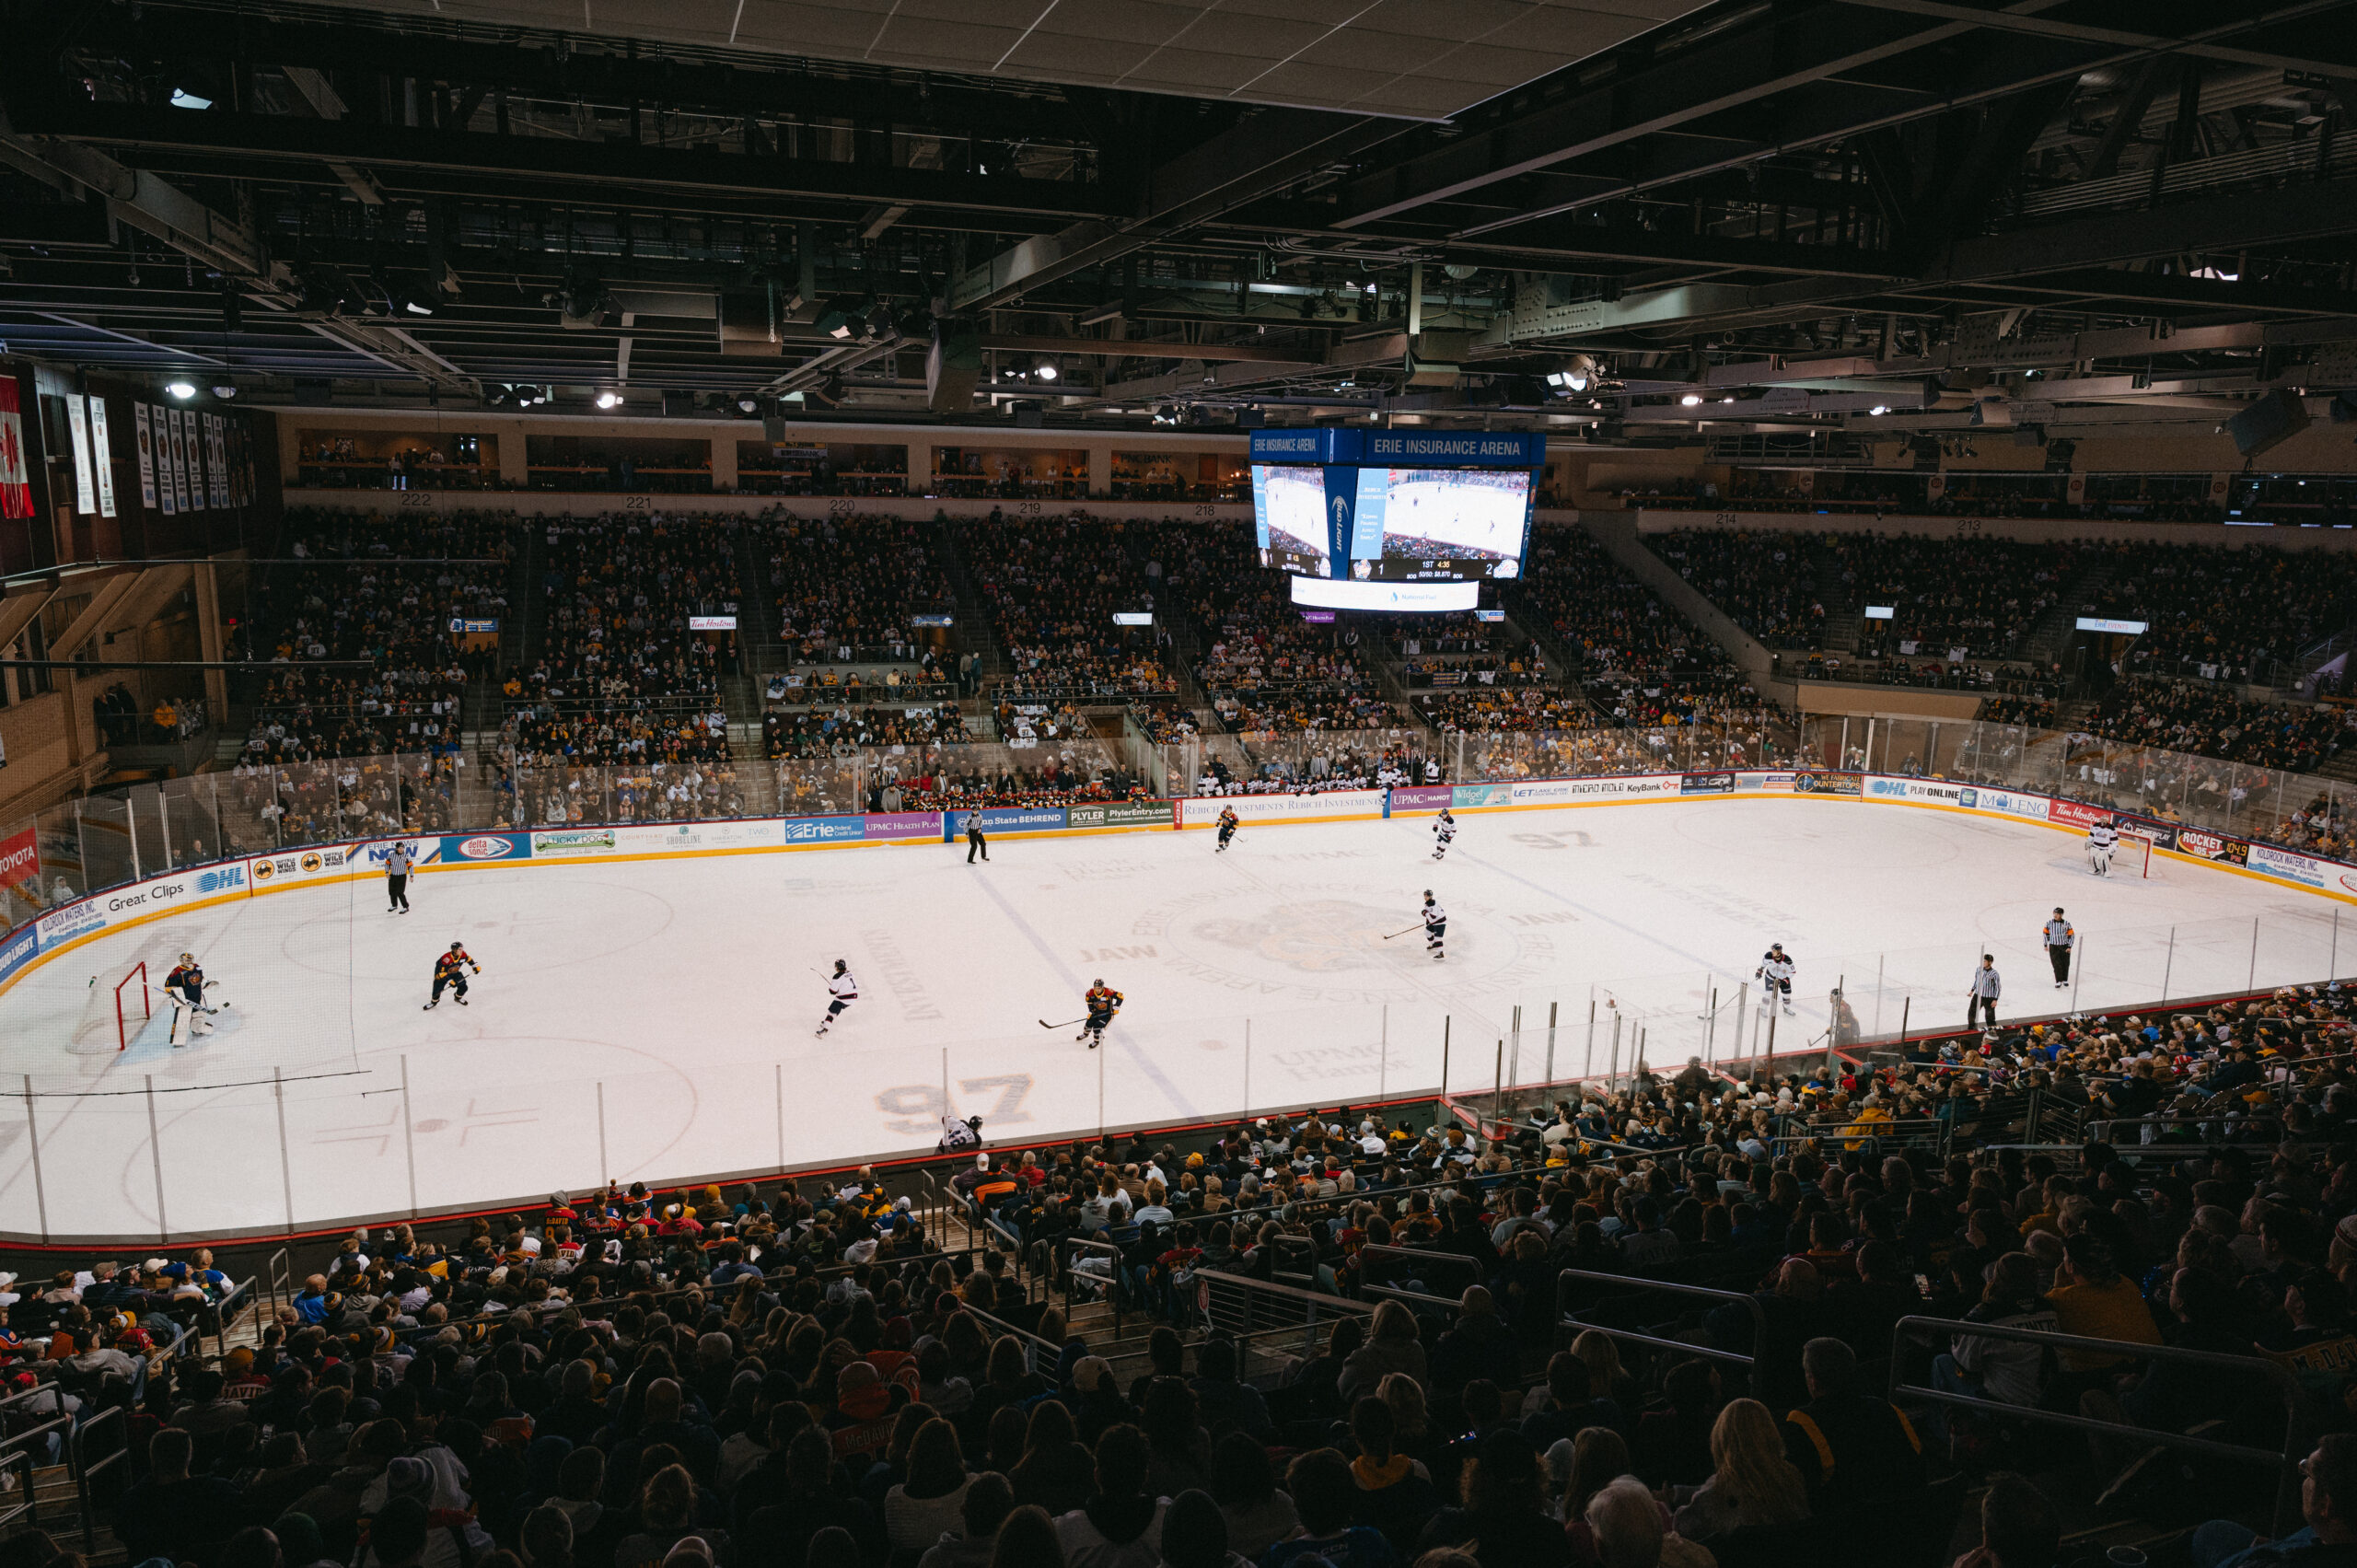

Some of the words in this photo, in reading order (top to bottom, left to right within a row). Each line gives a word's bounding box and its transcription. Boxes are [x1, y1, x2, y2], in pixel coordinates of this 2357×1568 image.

[1255, 439, 1265, 451] ERIE
[1266, 438, 1295, 451] INSURANCE
[1296, 438, 1316, 451] ARENA
[1374, 438, 1402, 454] ERIE
[1406, 438, 1477, 455] INSURANCE
[1480, 440, 1520, 456] ARENA
[401, 494, 431, 506] 222
[626, 497, 651, 508] 221
[830, 499, 855, 512] 220
[1019, 503, 1040, 514] 219
[1195, 505, 1214, 517] 218
[1716, 513, 1736, 524] 214
[1957, 519, 1981, 530] 213
[1314, 561, 1318, 572] 2
[1378, 563, 1383, 575] 1
[1485, 563, 1492, 575] 2
[691, 619, 704, 628] Tim
[705, 618, 735, 627] Hortons
[1455, 788, 1483, 799] Widget
[1514, 789, 1535, 797] LET
[1572, 784, 1599, 794] MICRO
[1602, 783, 1623, 792] MOLD
[1627, 783, 1661, 793] KeyBank
[1870, 780, 1907, 796] OHL
[1910, 785, 1926, 796] PLAY
[1927, 788, 1959, 800] ONLINE
[1288, 799, 1322, 809] REBICH
[1325, 798, 1384, 807] INVESTMENTS
[1393, 794, 1423, 805] UPMC
[1427, 794, 1450, 802] HAMOT
[1109, 808, 1171, 818] PlylerEntry.com
[1185, 805, 1220, 815] REBICH
[1223, 802, 1284, 812] IVESTMENTS
[2055, 803, 2072, 817] Tim
[2073, 806, 2102, 823] Horton
[994, 816, 1017, 825] State
[1019, 814, 1062, 823] BEHREND
[1071, 811, 1104, 820] PLYLER
[803, 822, 834, 838] Erie
[865, 822, 892, 831] UPMC
[894, 821, 921, 830] HEALTH
[922, 820, 940, 829] PLAN
[547, 835, 579, 844] LUCKY
[581, 834, 604, 842] DOG
[667, 834, 702, 845] SHORELINE
[2134, 828, 2170, 841] POWERPLAY
[2182, 831, 2223, 848] ROCKET
[368, 842, 389, 851] ERIE
[468, 839, 487, 849] delta
[2225, 842, 2247, 856] 104.9
[469, 847, 488, 856] sonic
[2193, 845, 2207, 855] 105
[2230, 854, 2242, 863] FM
[2257, 848, 2284, 864] KOLDROCK
[193, 867, 245, 893] OHL
[109, 893, 147, 912] Great
[151, 884, 184, 899] Clips
[0, 948, 12, 970] UD
[11, 936, 34, 958] LIGHT
[1270, 1041, 1399, 1066] UPMC
[874, 1073, 1036, 1135] 97
[845, 1423, 895, 1448] McDAVI
